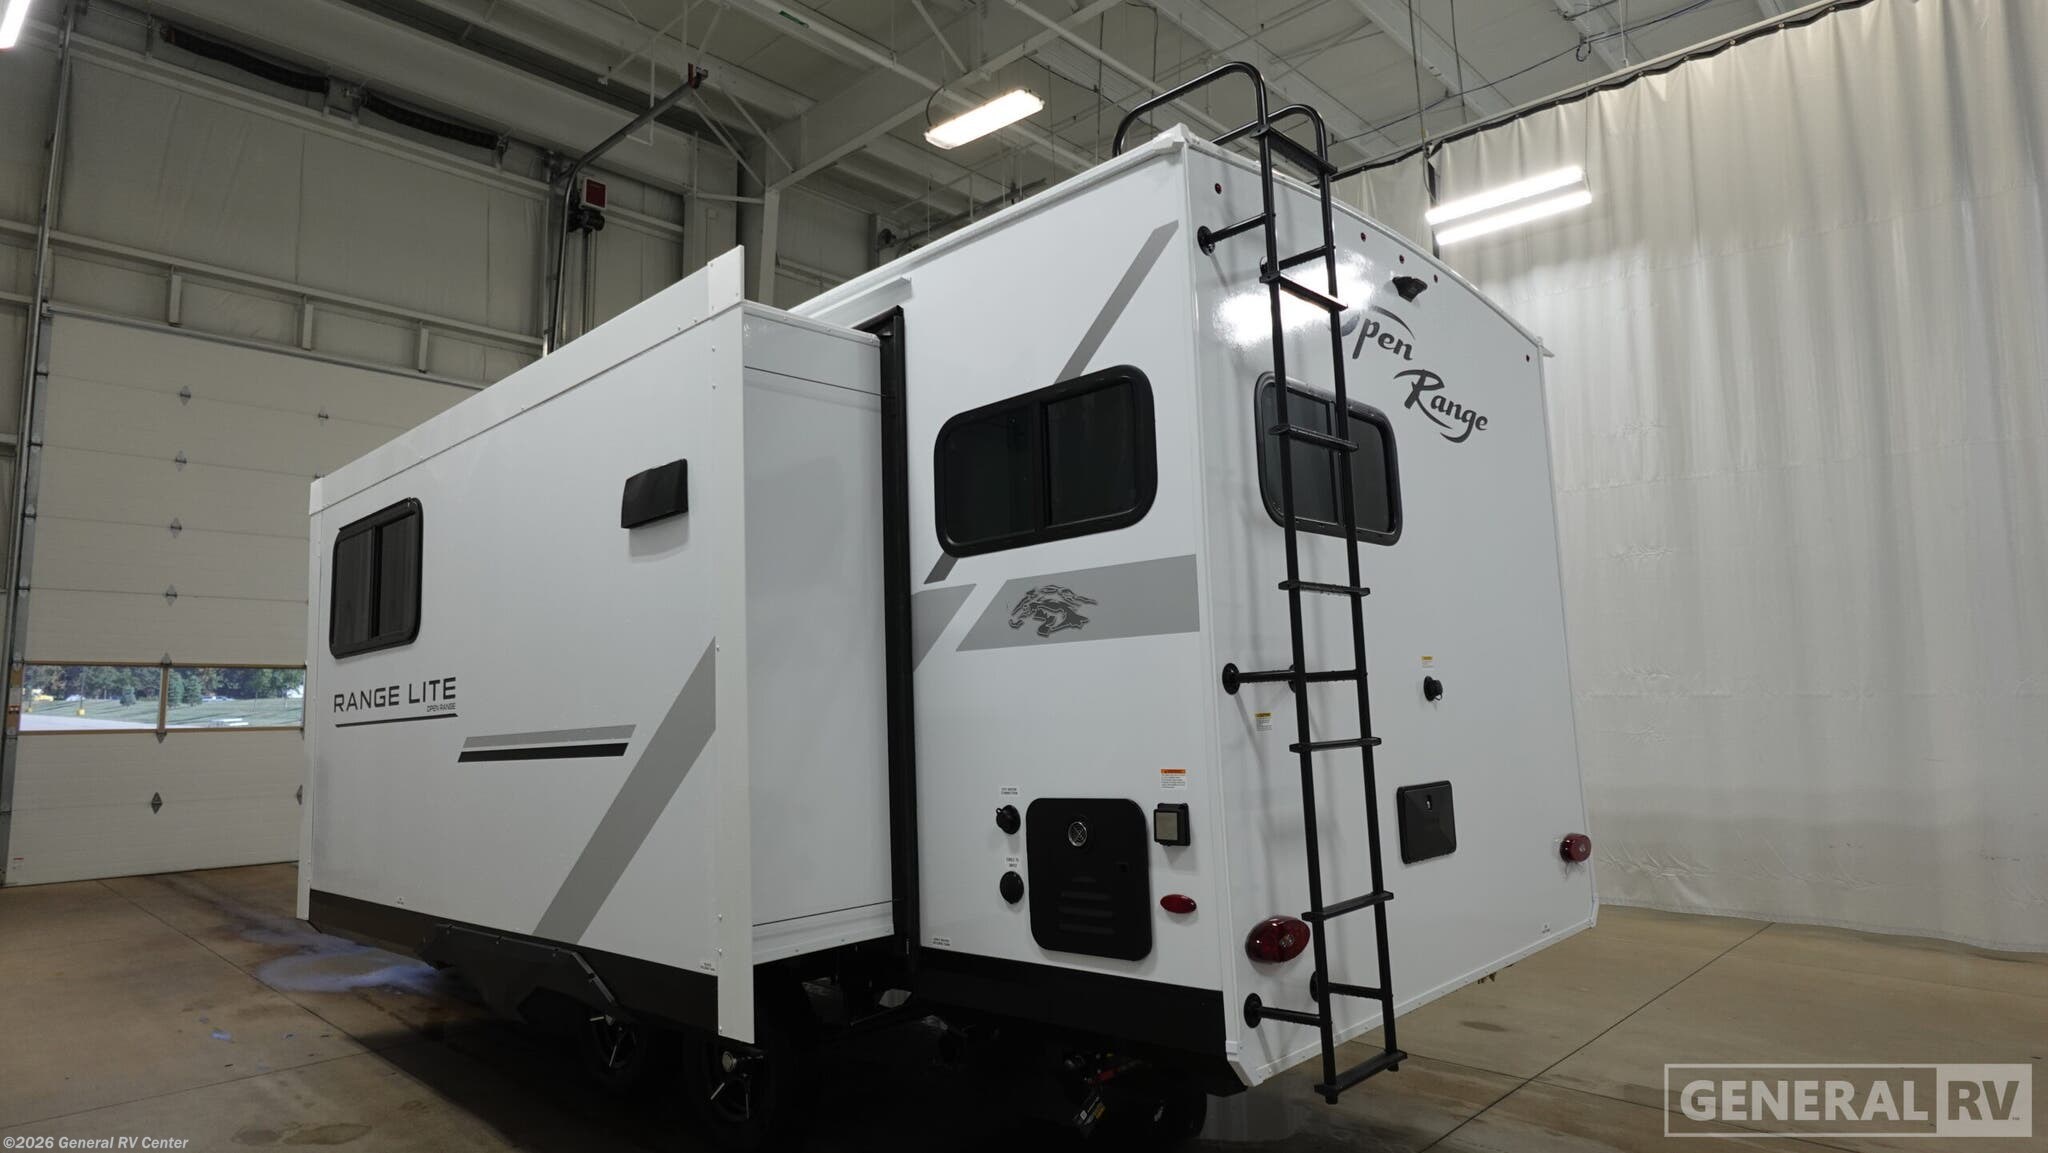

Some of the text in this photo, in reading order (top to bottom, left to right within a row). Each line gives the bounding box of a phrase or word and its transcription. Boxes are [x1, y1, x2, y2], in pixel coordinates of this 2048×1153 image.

[1393, 369, 1488, 443] Range
[334, 676, 457, 713] RANGE LITE
